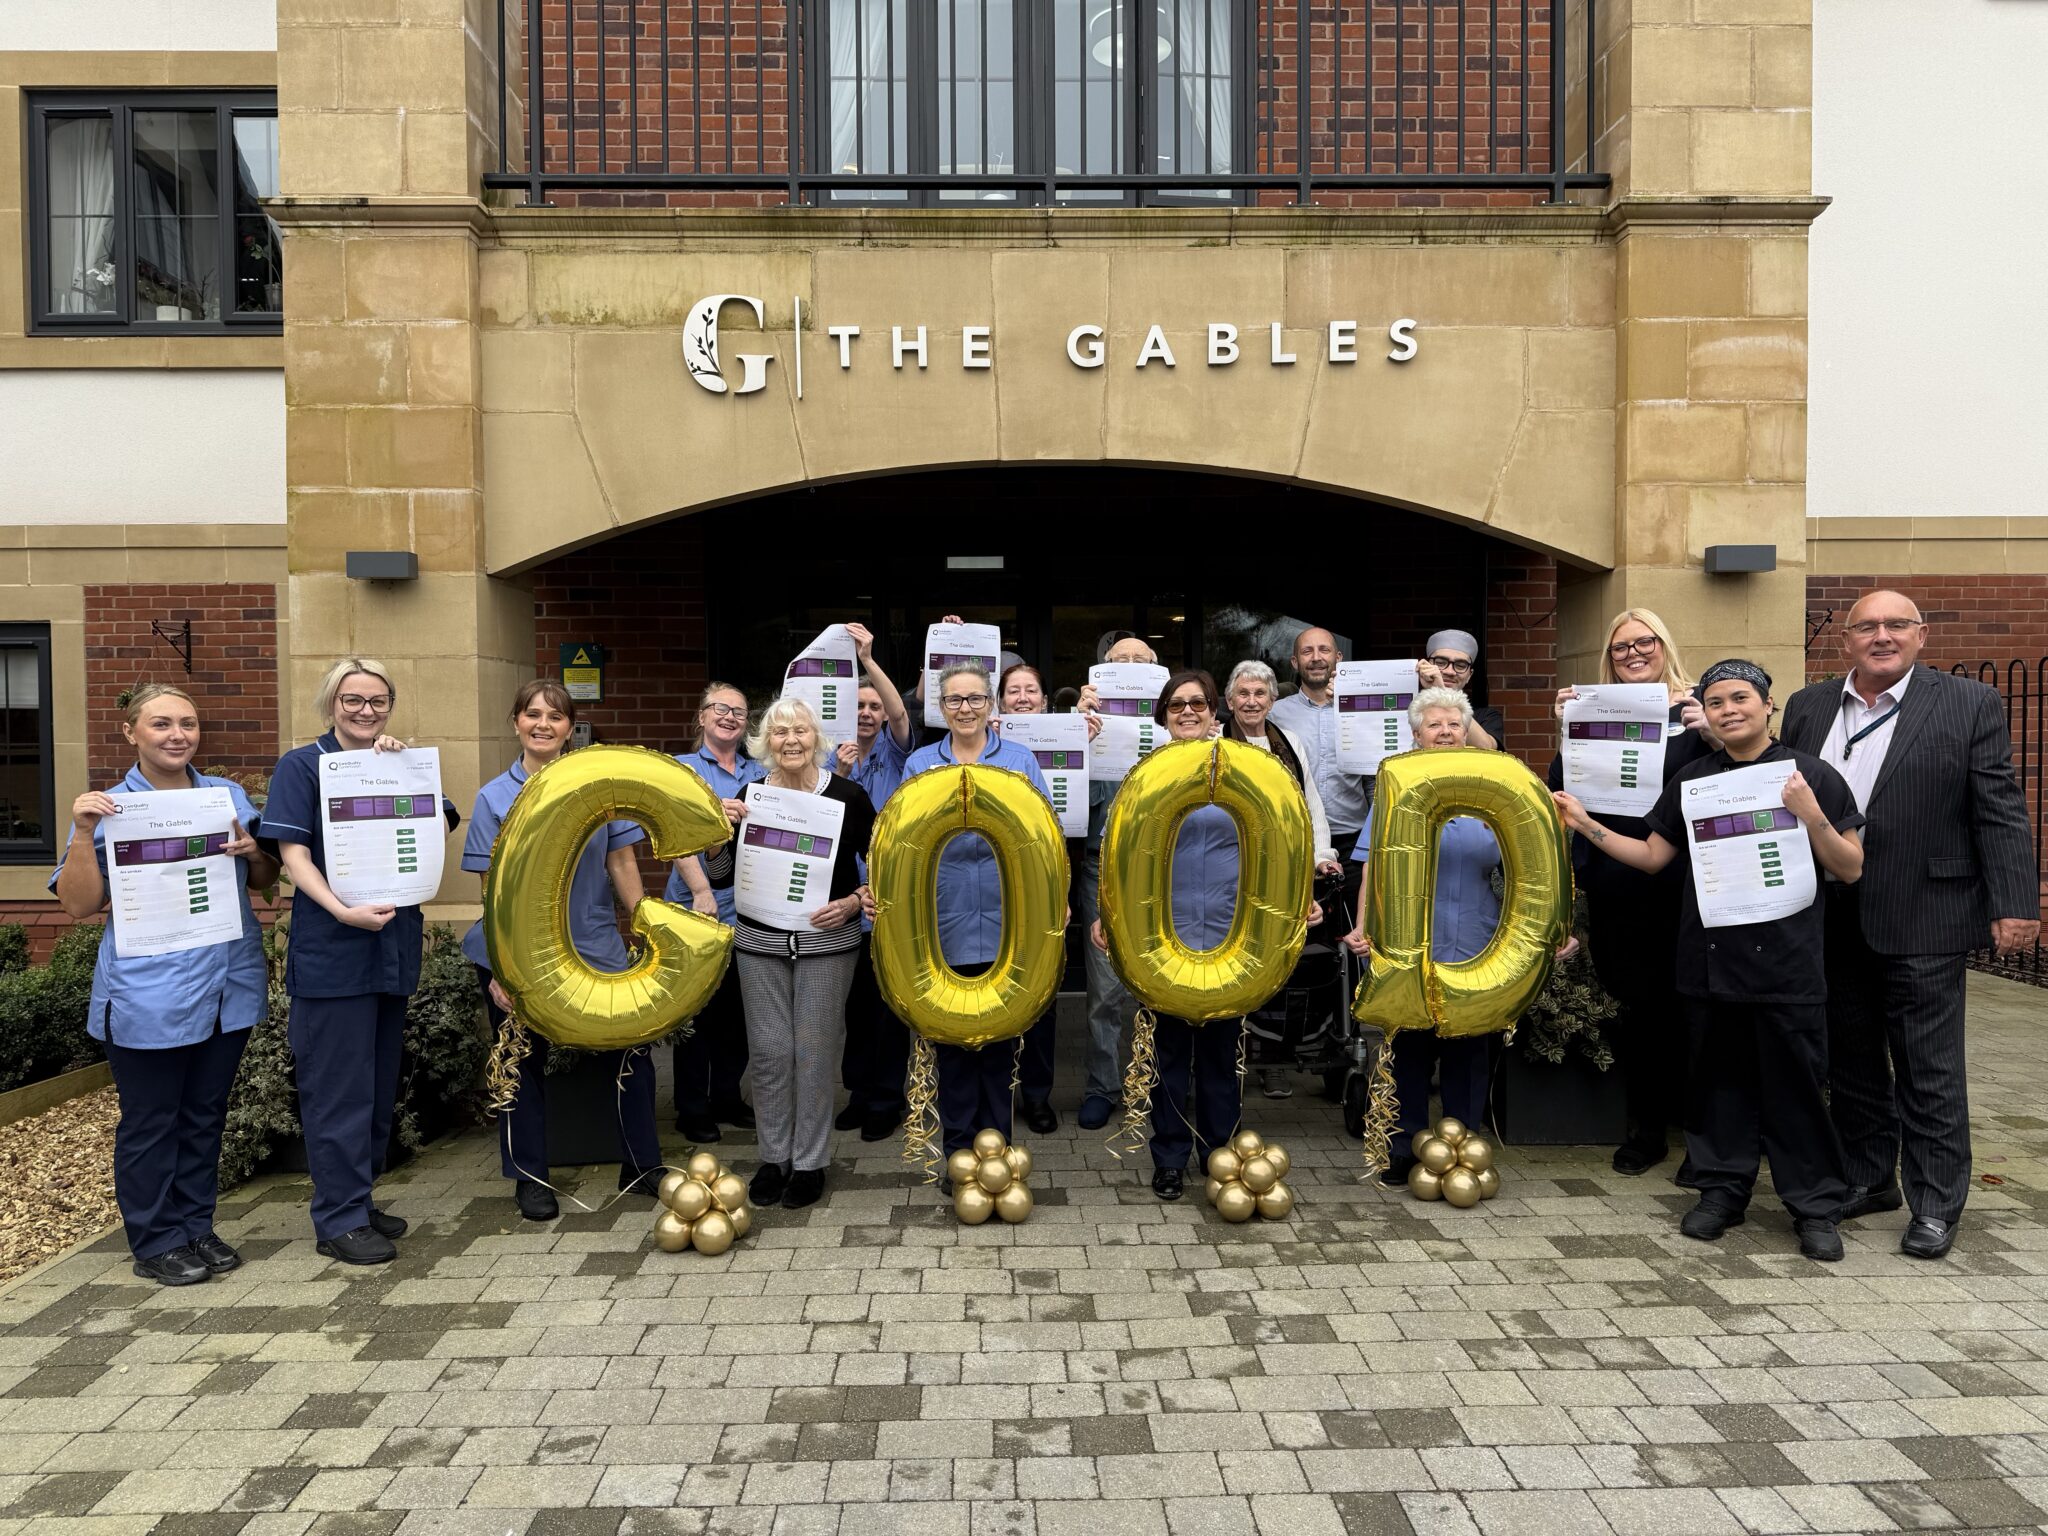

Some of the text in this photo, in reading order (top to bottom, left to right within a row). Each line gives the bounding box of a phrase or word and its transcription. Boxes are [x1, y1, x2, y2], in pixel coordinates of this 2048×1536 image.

[828, 318, 1418, 369] THE GABLES
[1718, 795, 1757, 806] The Gables
[149, 821, 164, 829] The
[165, 819, 193, 827] Gables
